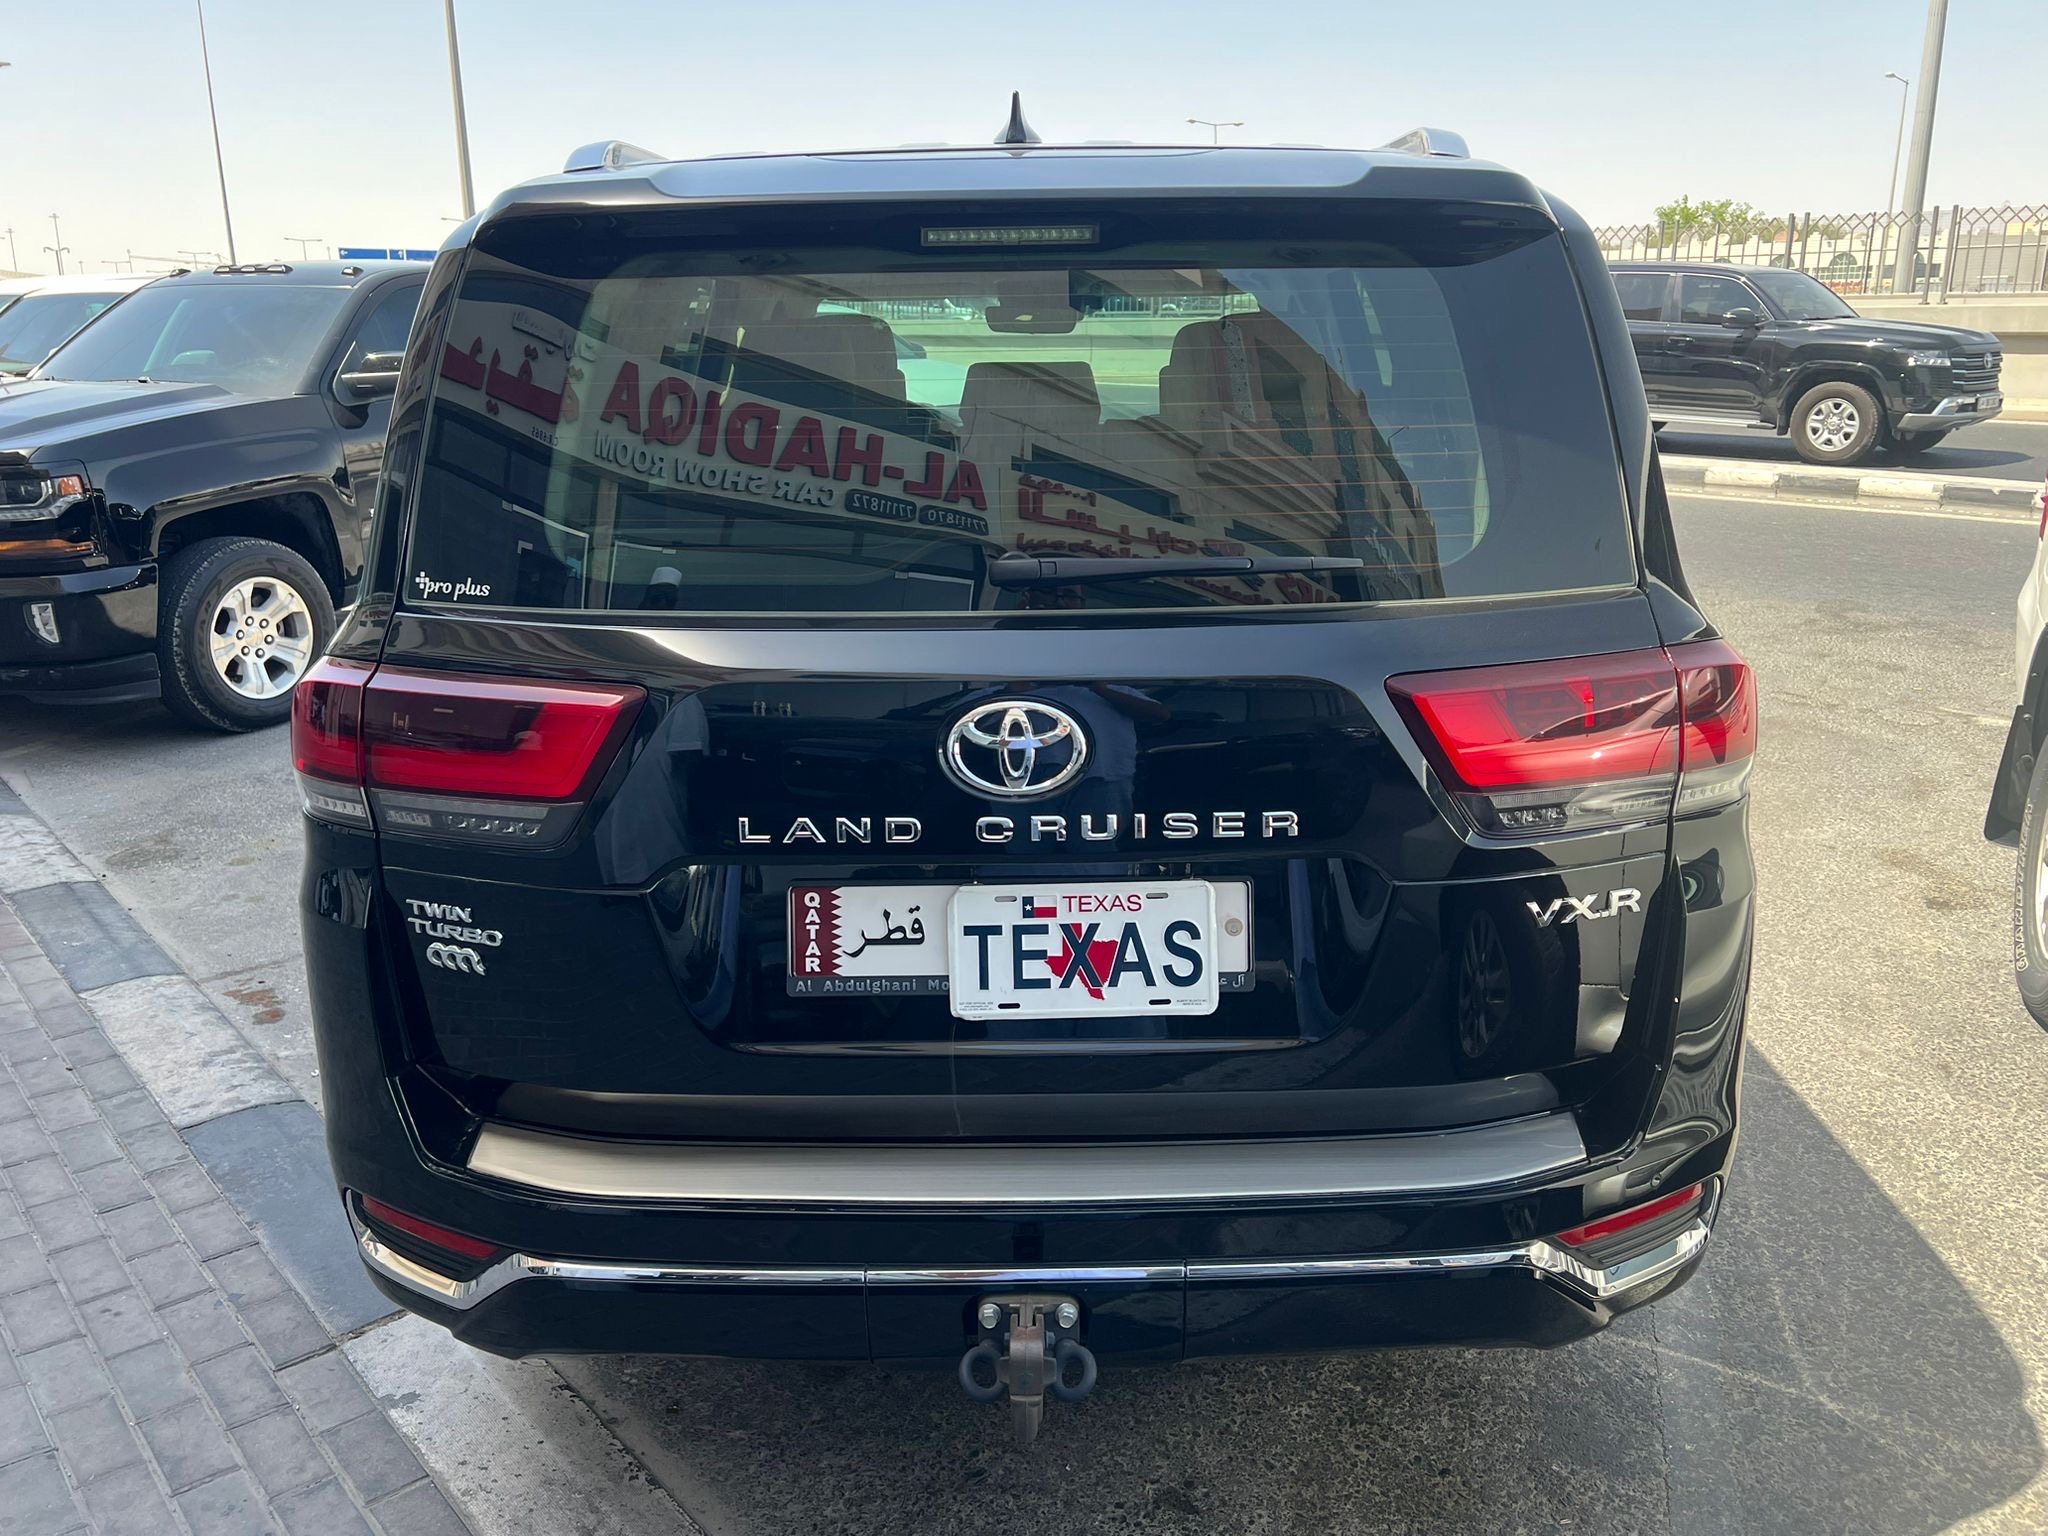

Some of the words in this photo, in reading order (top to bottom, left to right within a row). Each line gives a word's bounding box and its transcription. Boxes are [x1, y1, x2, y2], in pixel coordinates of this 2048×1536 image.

[423, 581, 452, 599] pro
[453, 577, 491, 601] plus
[738, 817, 922, 844] LAND
[975, 811, 1300, 843] CRUISER
[405, 899, 472, 923] TWIN
[1062, 894, 1142, 914] TEXAS
[407, 917, 503, 947] TURBO
[803, 892, 822, 973] QATAR
[842, 904, 926, 959] قطر
[963, 920, 1204, 991] TEXAS
[795, 980, 812, 992] Al
[823, 979, 917, 994] Abdulghani
